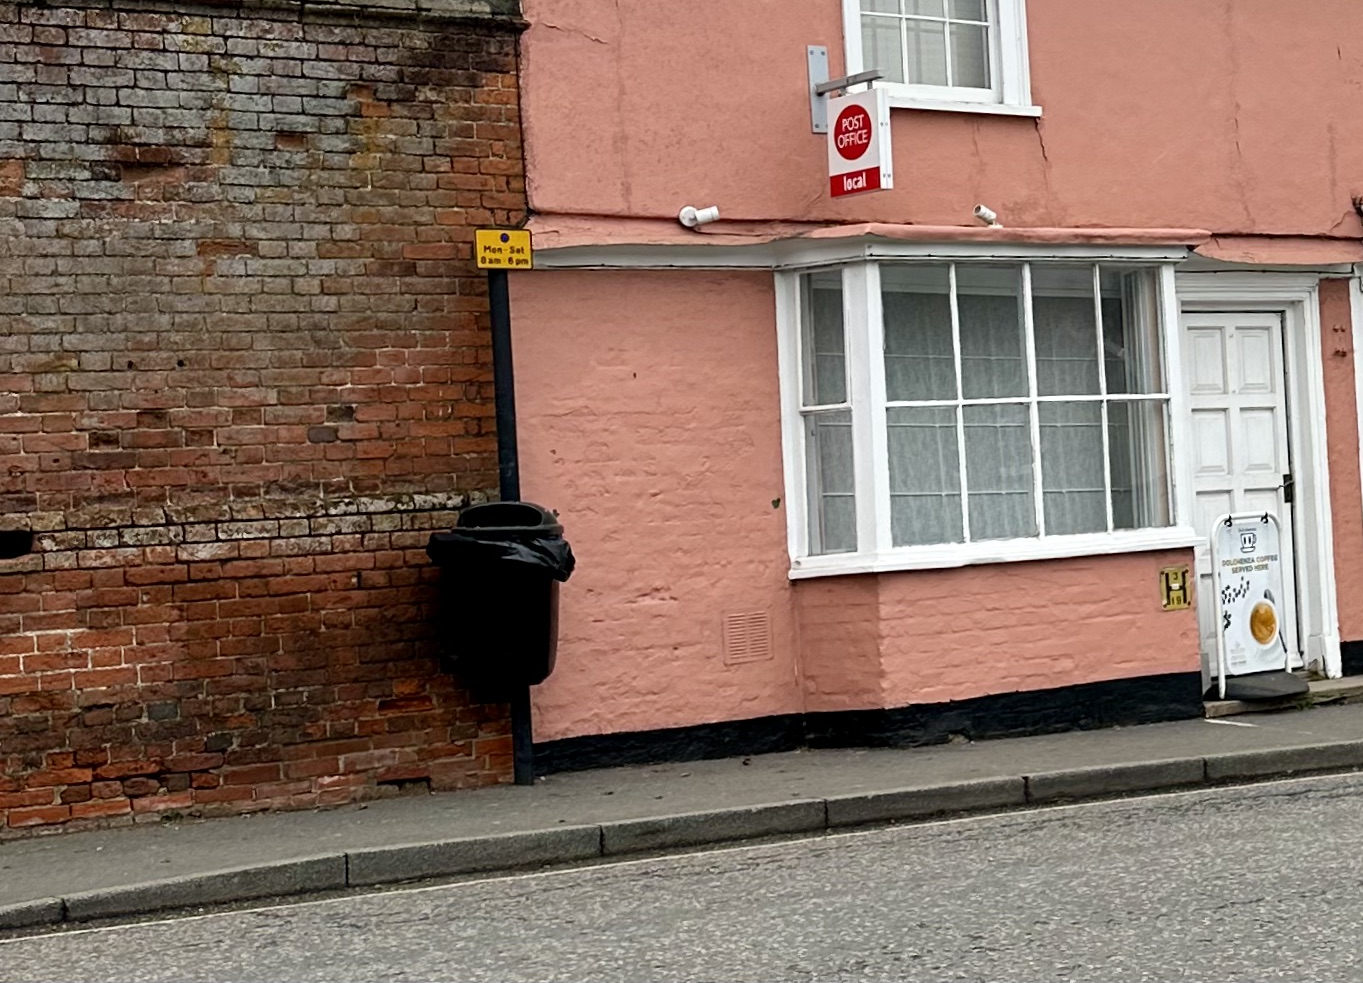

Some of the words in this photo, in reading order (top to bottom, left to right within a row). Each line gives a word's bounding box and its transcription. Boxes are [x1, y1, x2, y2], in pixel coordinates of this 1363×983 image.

[842, 114, 865, 132] POST
[837, 130, 868, 149] OFFICE
[843, 172, 867, 192] local
[483, 245, 502, 254] Mon
[509, 246, 525, 254] Sat
[1173, 572, 1178, 581] 3
